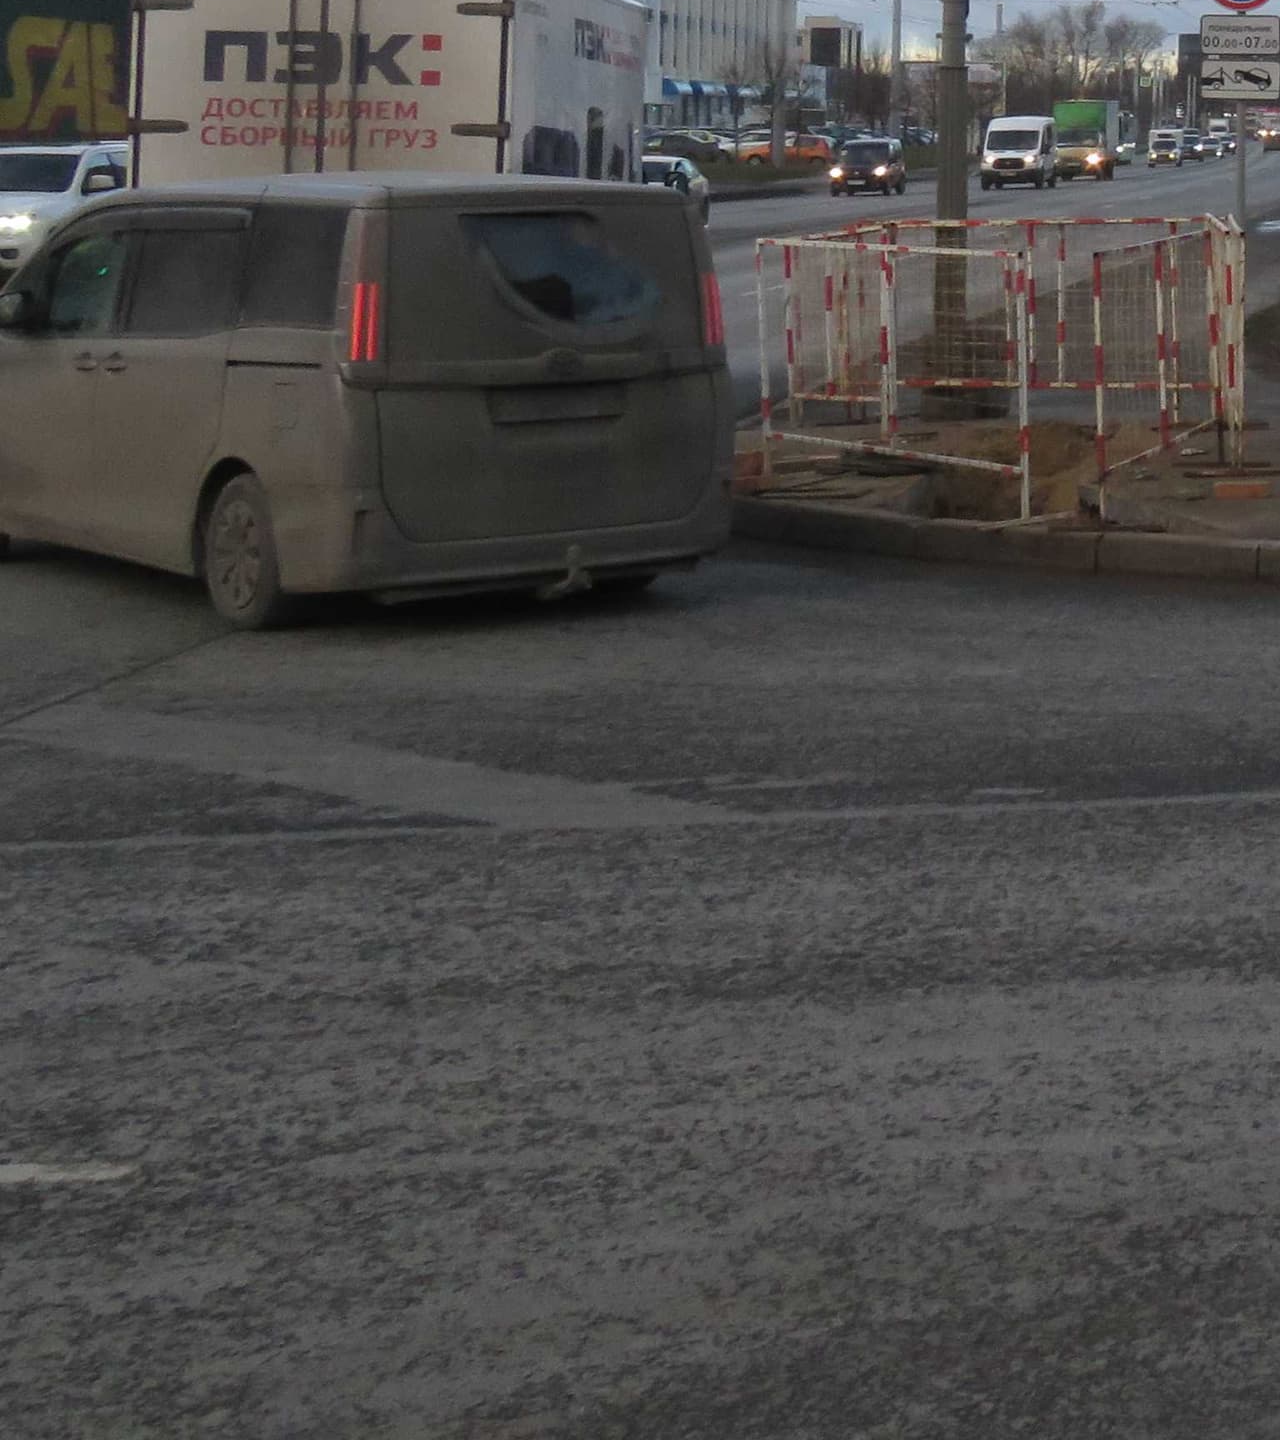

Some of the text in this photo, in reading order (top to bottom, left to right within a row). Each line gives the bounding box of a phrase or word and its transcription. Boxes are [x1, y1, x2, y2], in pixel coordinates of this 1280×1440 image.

[201, 97, 419, 121] ДОСТАВЛЯЕМ
[201, 124, 439, 150] СБОРНЫЙ ГРУЗ
